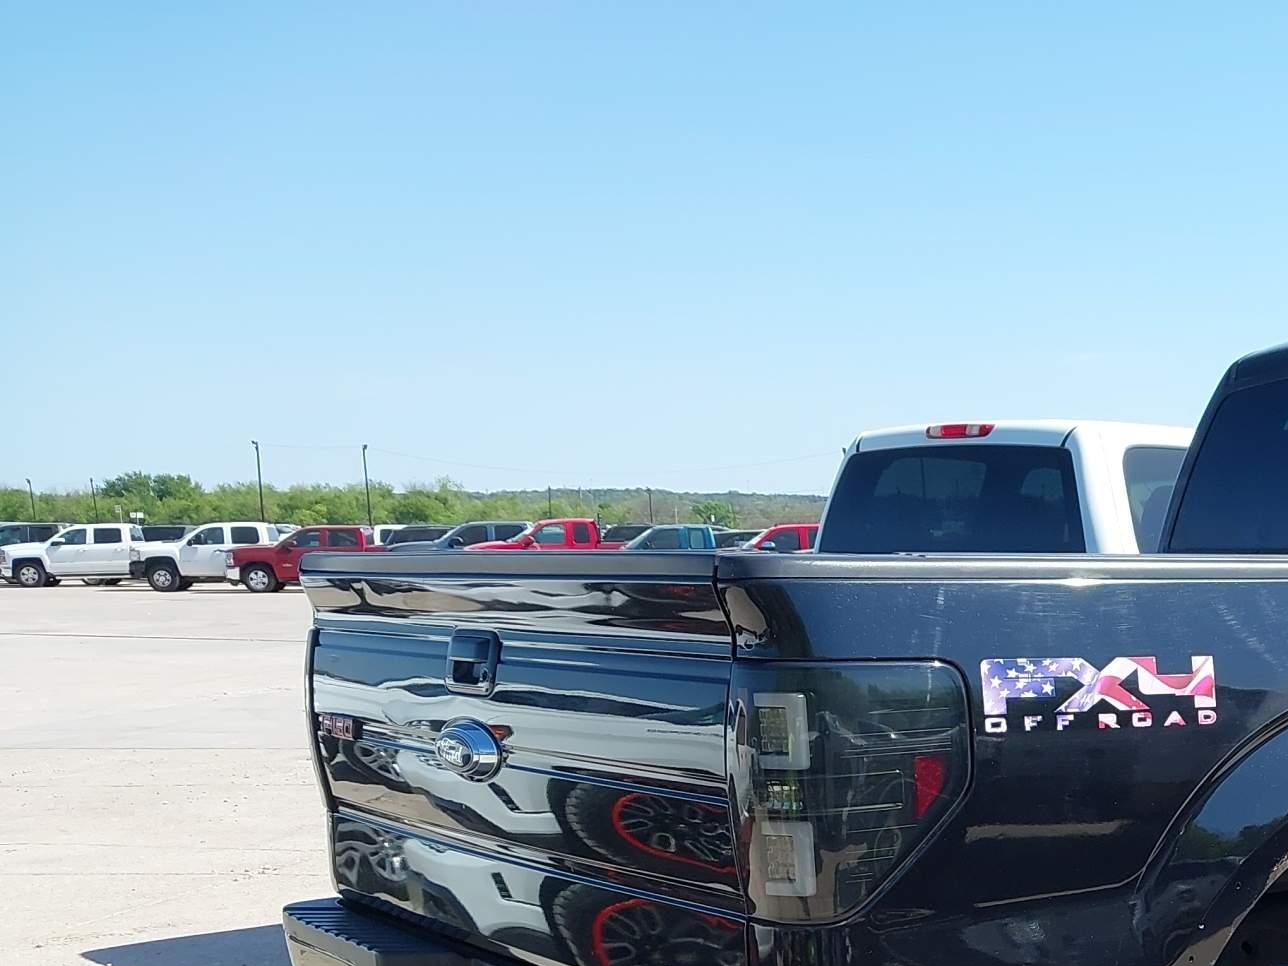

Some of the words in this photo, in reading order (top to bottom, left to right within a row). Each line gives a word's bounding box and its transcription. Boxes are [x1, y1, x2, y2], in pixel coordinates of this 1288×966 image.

[980, 655, 1217, 716] FX4
[984, 714, 1075, 734] OFF
[1098, 709, 1217, 730] ROAD
[437, 737, 465, 766] Ford
